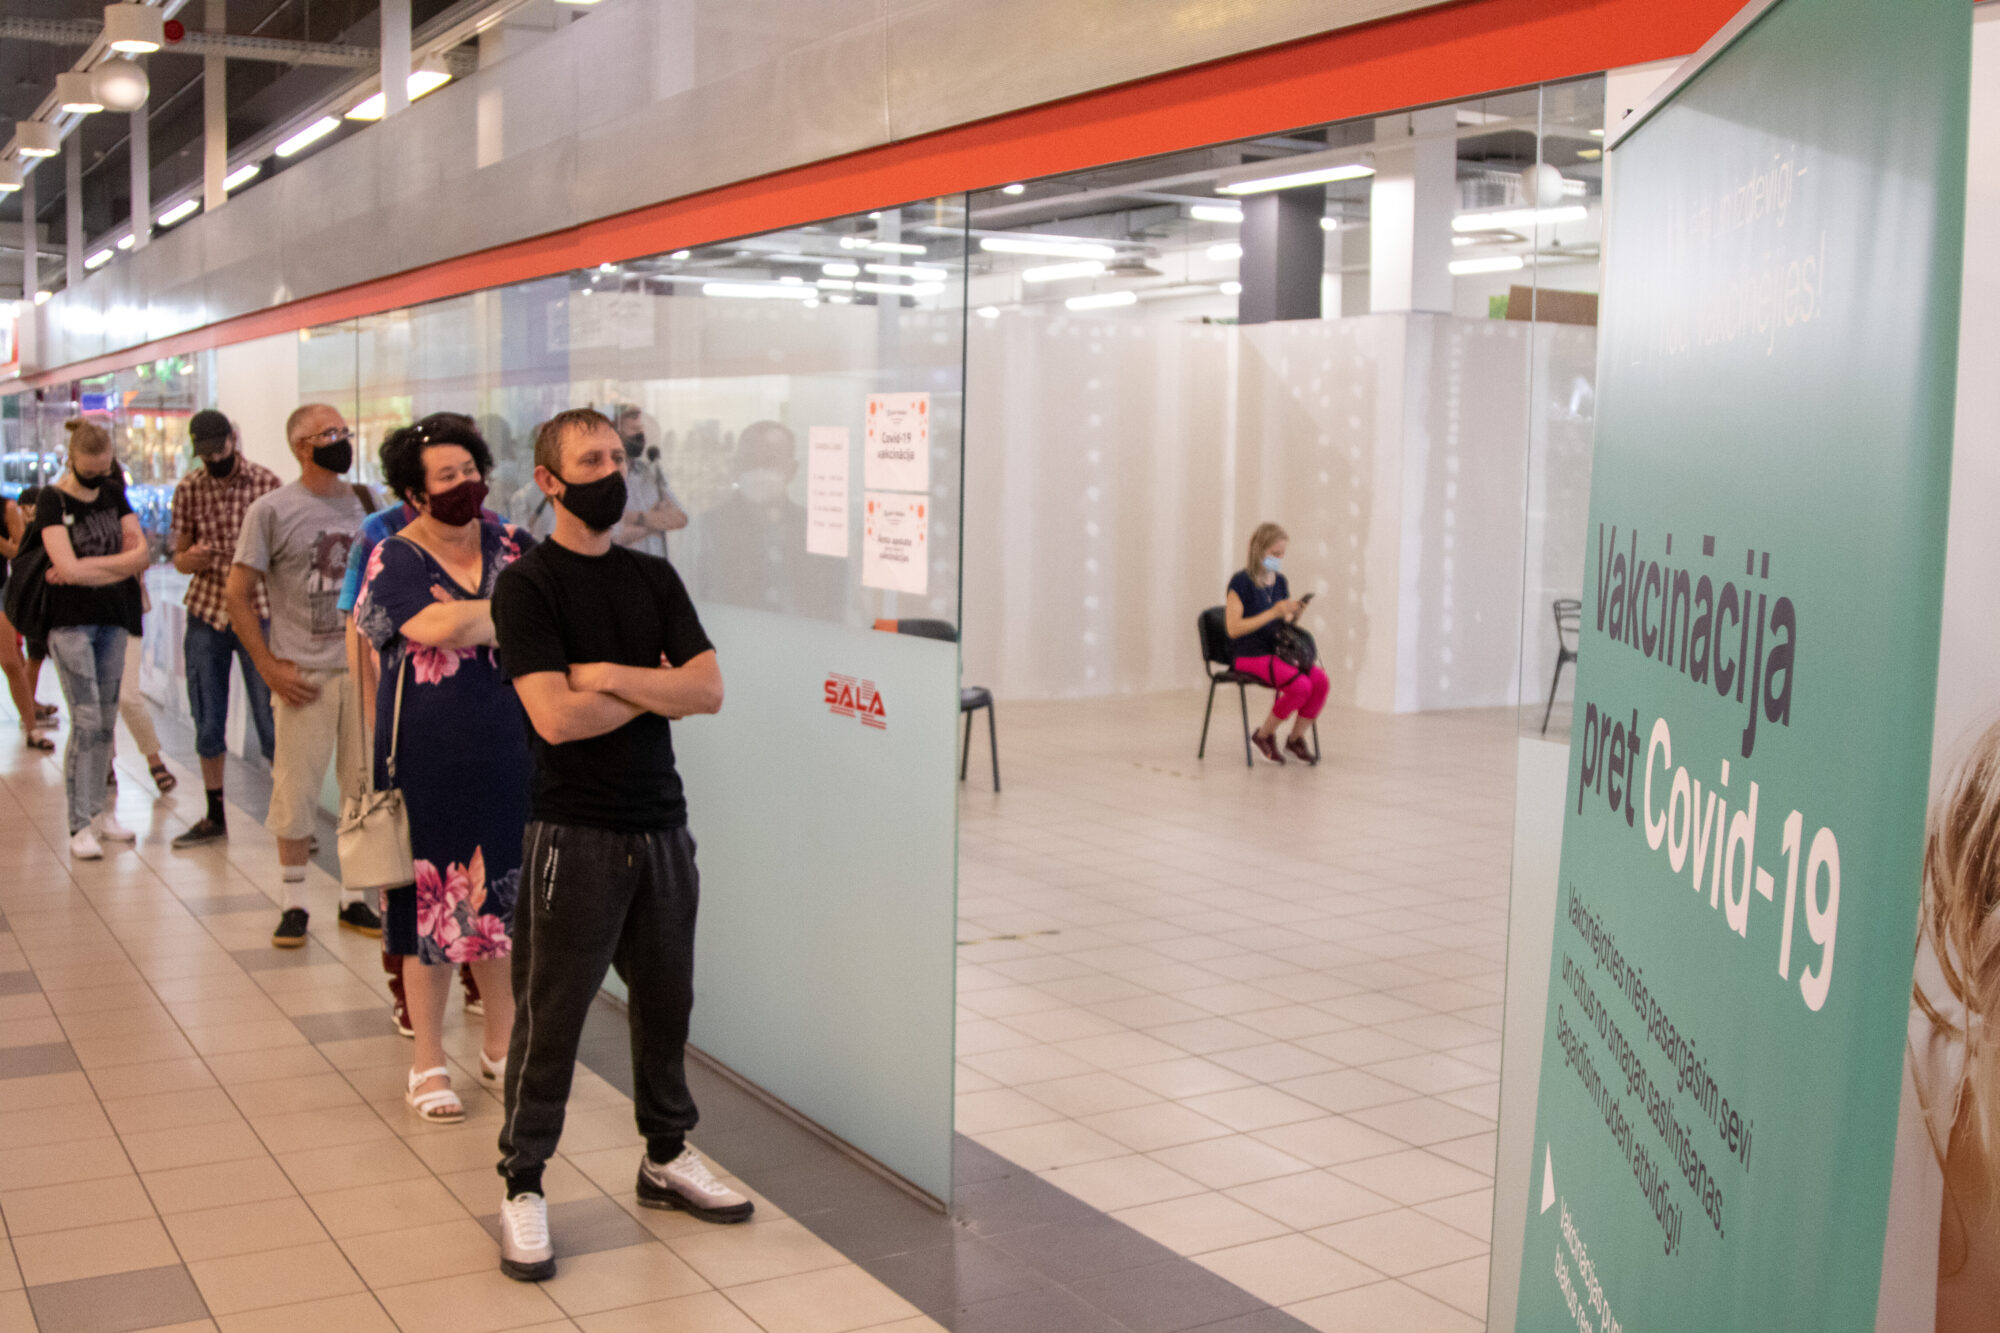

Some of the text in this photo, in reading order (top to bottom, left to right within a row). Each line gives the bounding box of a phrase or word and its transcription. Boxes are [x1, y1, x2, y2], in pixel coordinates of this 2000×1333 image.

[881, 431, 912, 444] Covid-19
[823, 679, 887, 718] SALA
[1597, 522, 1797, 759] Vakcinācija
[1578, 701, 1841, 1012] pret Covid-19
[1556, 1003, 1684, 1257] Sagaidīsim rudeni atbildīgi!
[1562, 951, 1725, 1240] un citus no smagas saslimšanas.
[1568, 880, 1754, 1174] Vakcinējoties mēs pasargāsim sevi
[1554, 1243, 1578, 1318] blakus
[1560, 1195, 1603, 1315] Vakcinācijas
